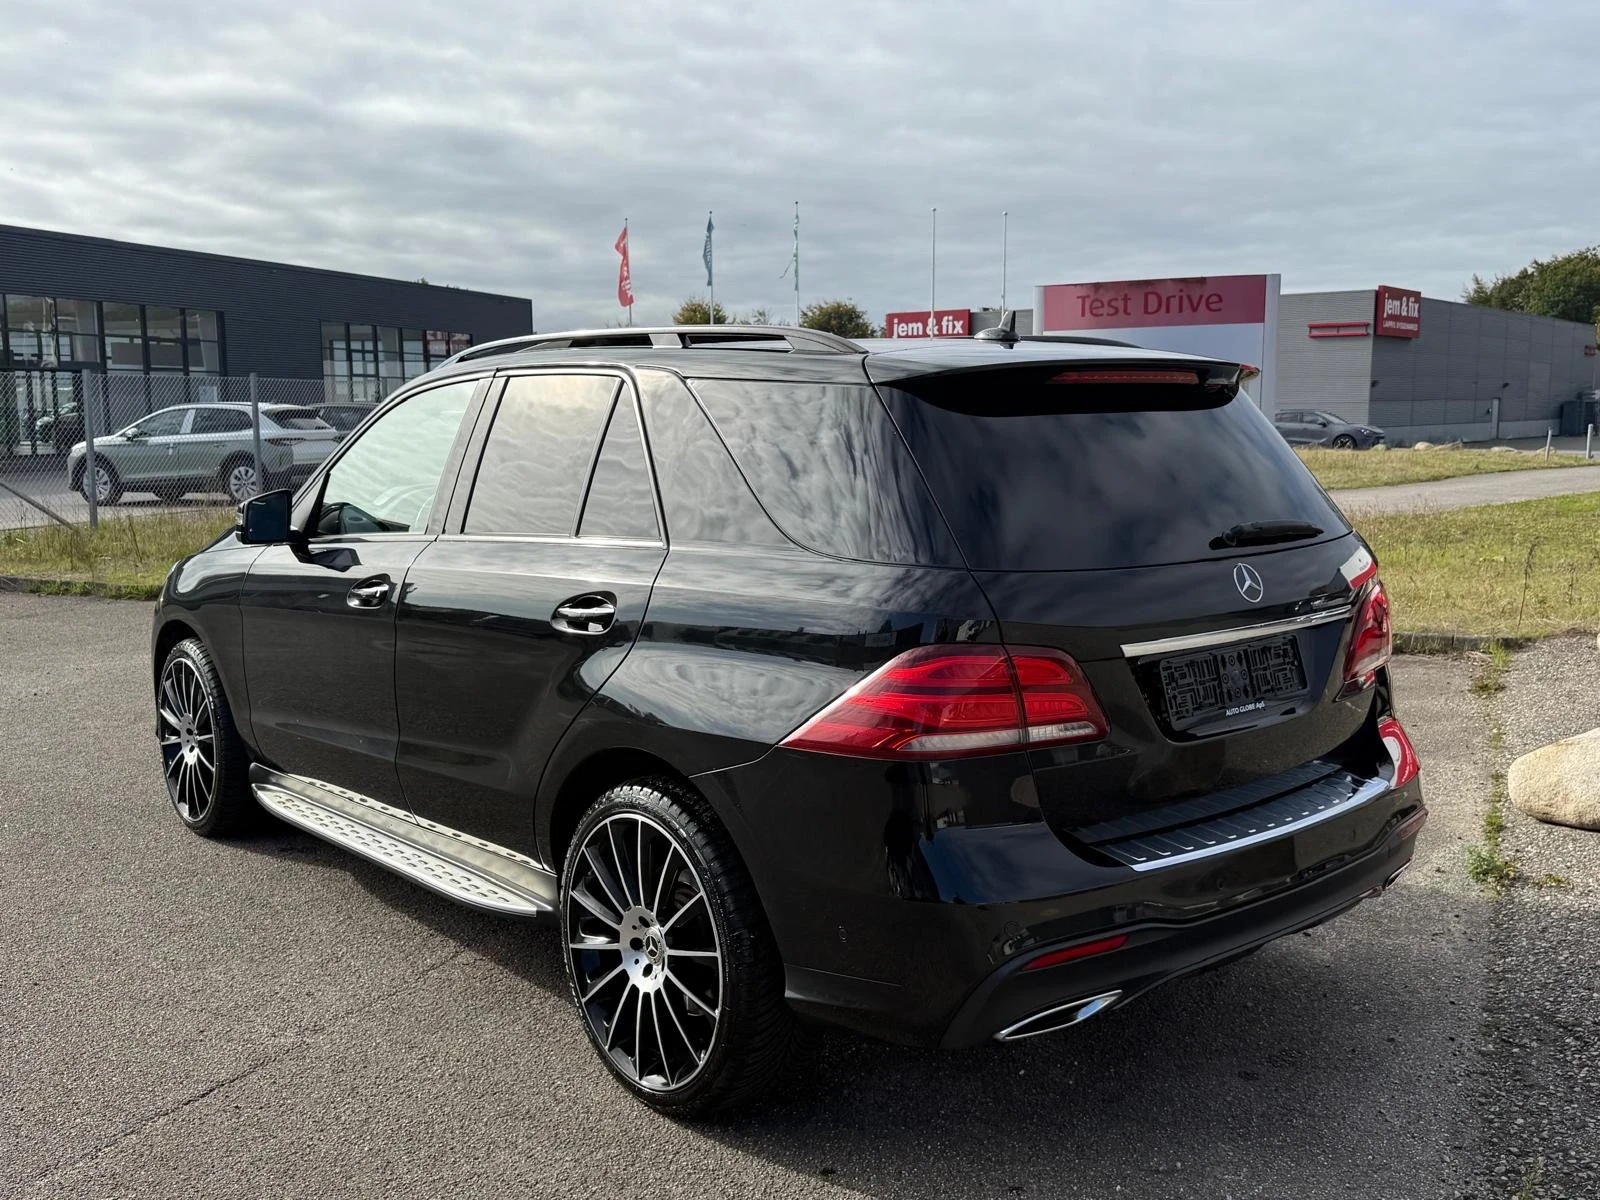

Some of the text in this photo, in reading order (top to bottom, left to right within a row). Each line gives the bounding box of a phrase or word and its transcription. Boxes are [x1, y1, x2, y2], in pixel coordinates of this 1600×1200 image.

[1076, 288, 1224, 318] Test Drive
[1383, 292, 1419, 318] jem & fix
[892, 315, 964, 339] jem & fix
[1225, 707, 1239, 716] AUTO
